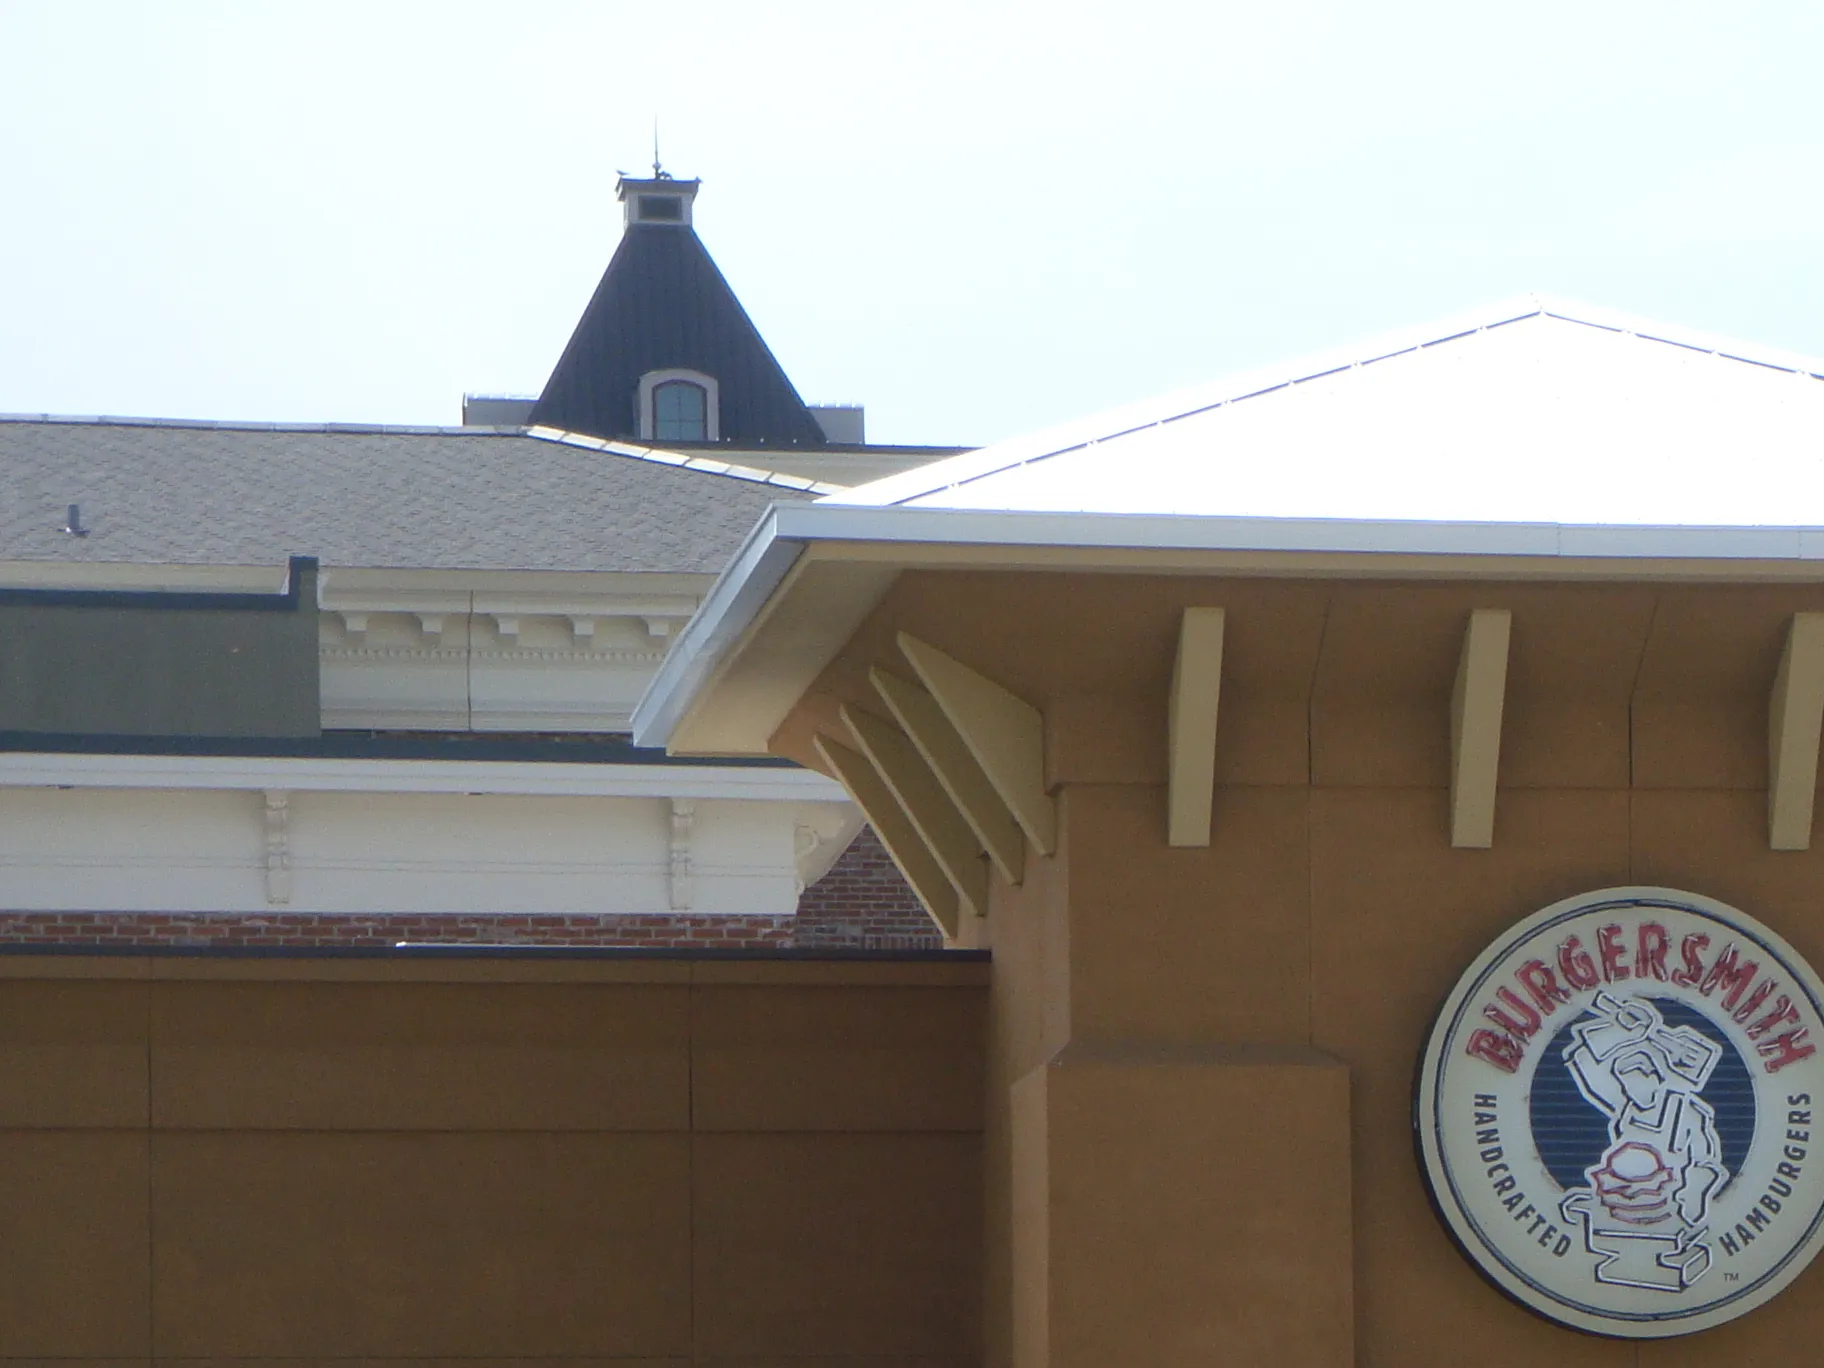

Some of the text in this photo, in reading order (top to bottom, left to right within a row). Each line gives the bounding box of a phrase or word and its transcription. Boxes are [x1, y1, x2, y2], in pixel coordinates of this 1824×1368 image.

[1466, 923, 1816, 1074] BURGERSMITH
[1474, 1093, 1571, 1259] HANDCRAFTED
[1719, 1092, 1812, 1257] HAMBURGERS
